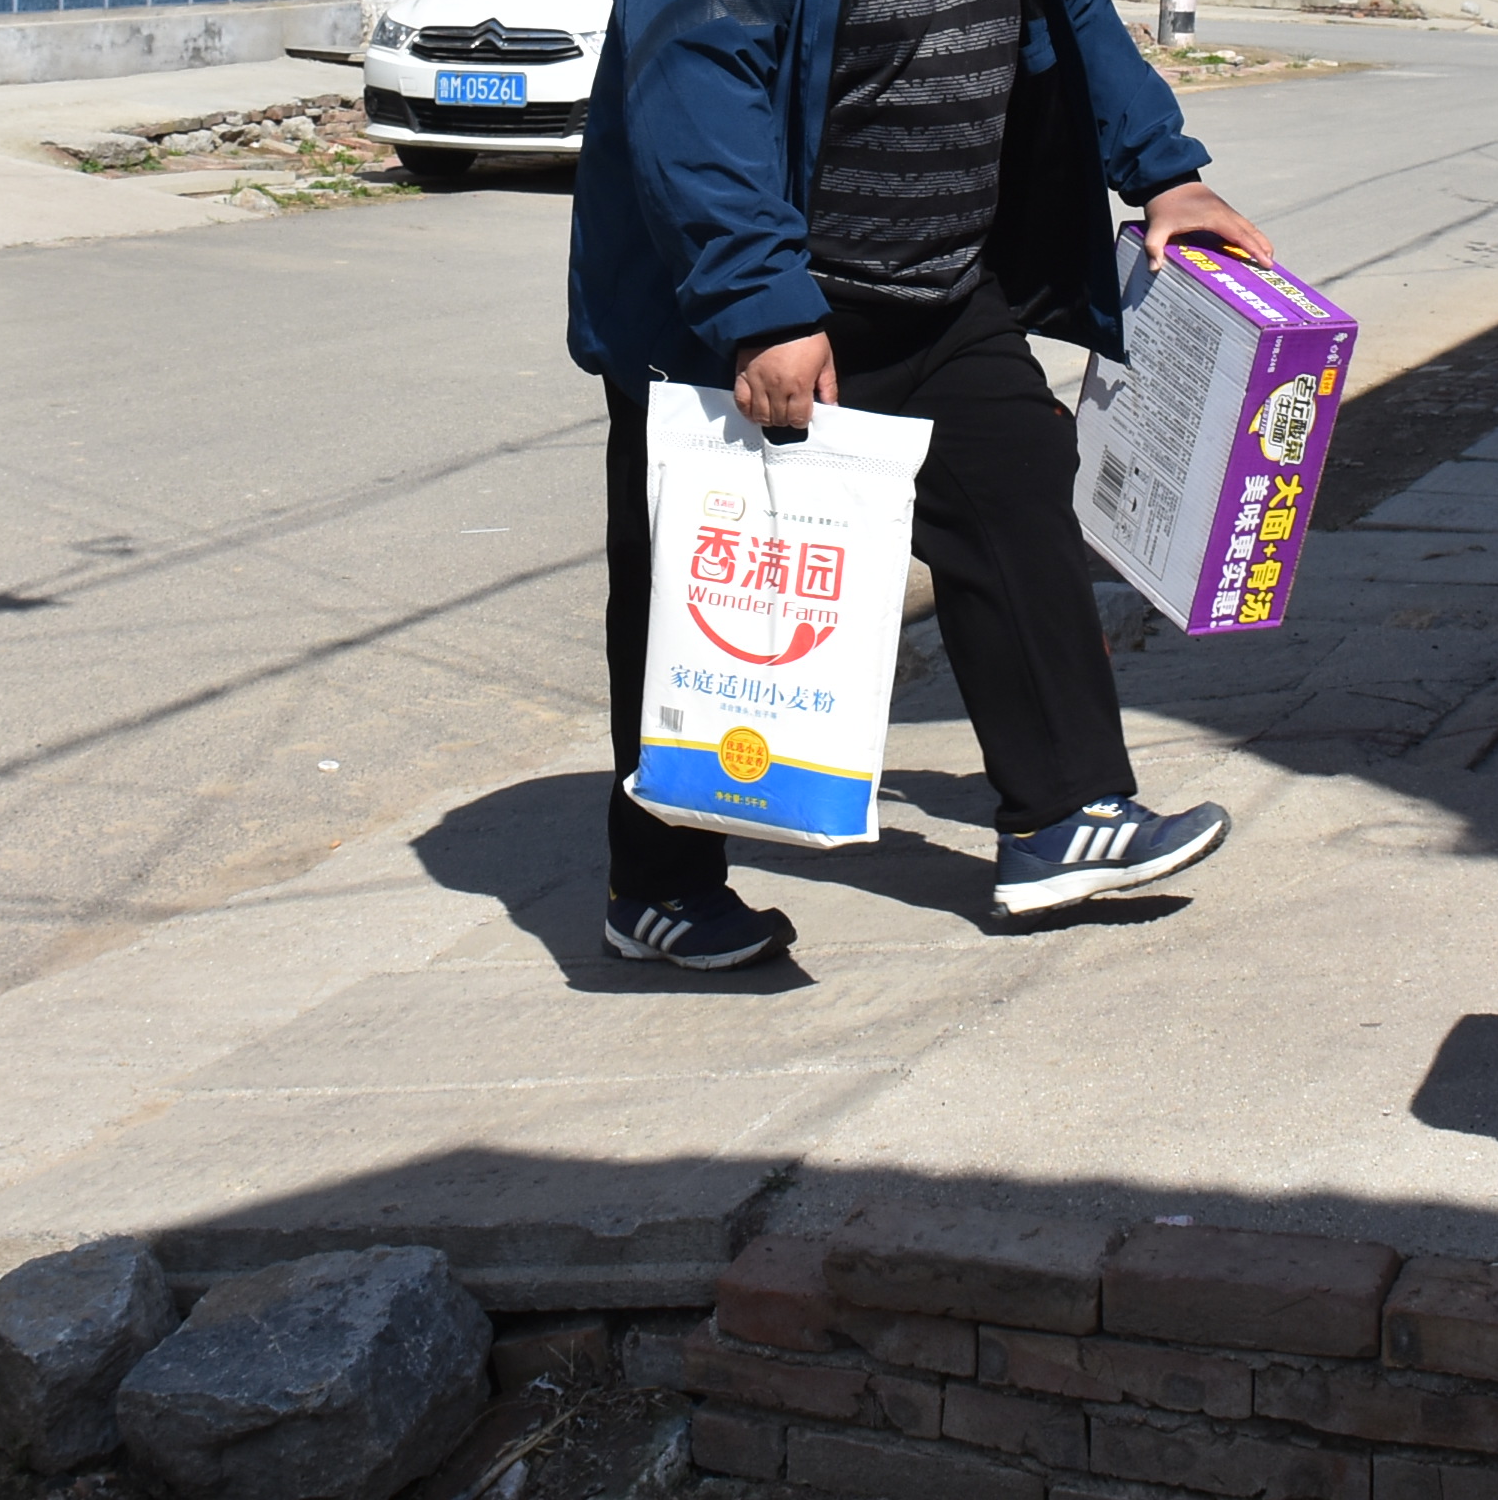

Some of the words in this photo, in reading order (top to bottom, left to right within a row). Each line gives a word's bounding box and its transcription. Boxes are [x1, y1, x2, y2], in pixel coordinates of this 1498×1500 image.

[1272, 397, 1292, 443] 牛肉面
[1284, 375, 1315, 462] 老坛酸菜
[690, 525, 845, 601] 香满园
[1209, 474, 1271, 628] 美味更实惠!
[1239, 474, 1303, 623] 大面+骨汤
[688, 584, 775, 615] Wonder
[782, 601, 839, 624] Farm
[670, 664, 836, 714] 家庭适用小麦粉
[725, 751, 764, 768] 阳光麦香
[726, 740, 765, 757] 优选小麦
